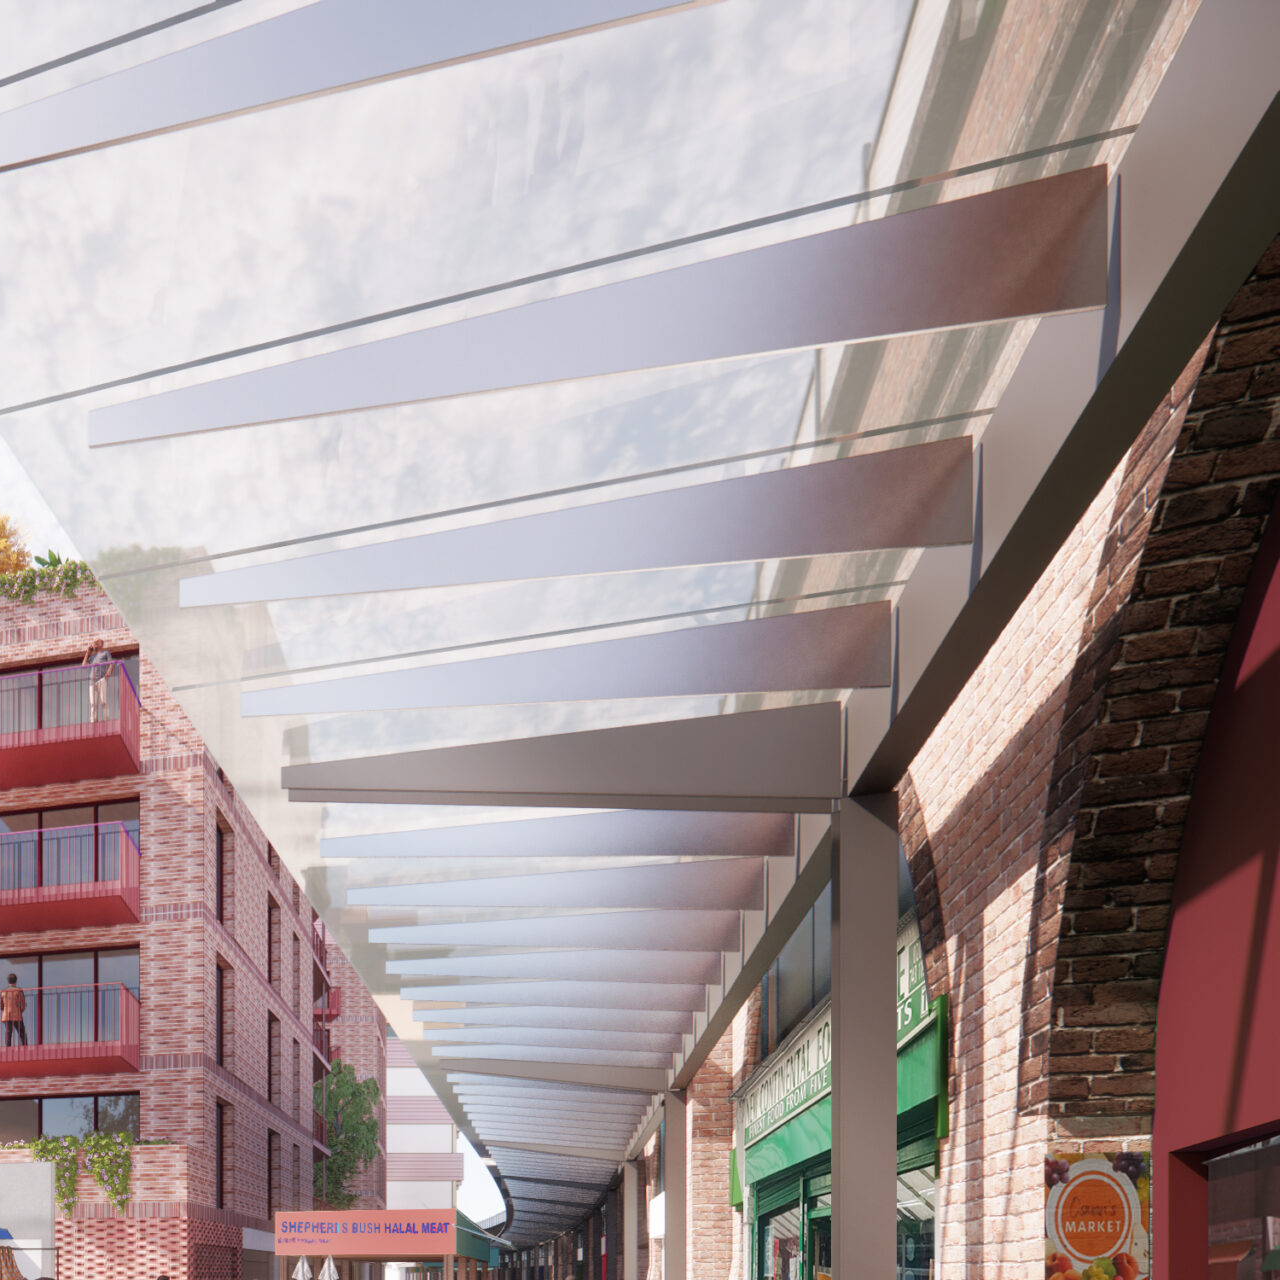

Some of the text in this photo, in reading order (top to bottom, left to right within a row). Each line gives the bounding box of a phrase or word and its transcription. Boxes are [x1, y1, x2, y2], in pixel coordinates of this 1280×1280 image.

[760, 1039, 810, 1113] CONTINENTAL
[749, 1066, 828, 1139] FINEST FOOD FROM FIVE
[352, 1222, 381, 1234] BUSH
[384, 1222, 419, 1234] HALAL
[422, 1222, 450, 1234] MEAT
[1065, 1221, 1121, 1233] MARKET
